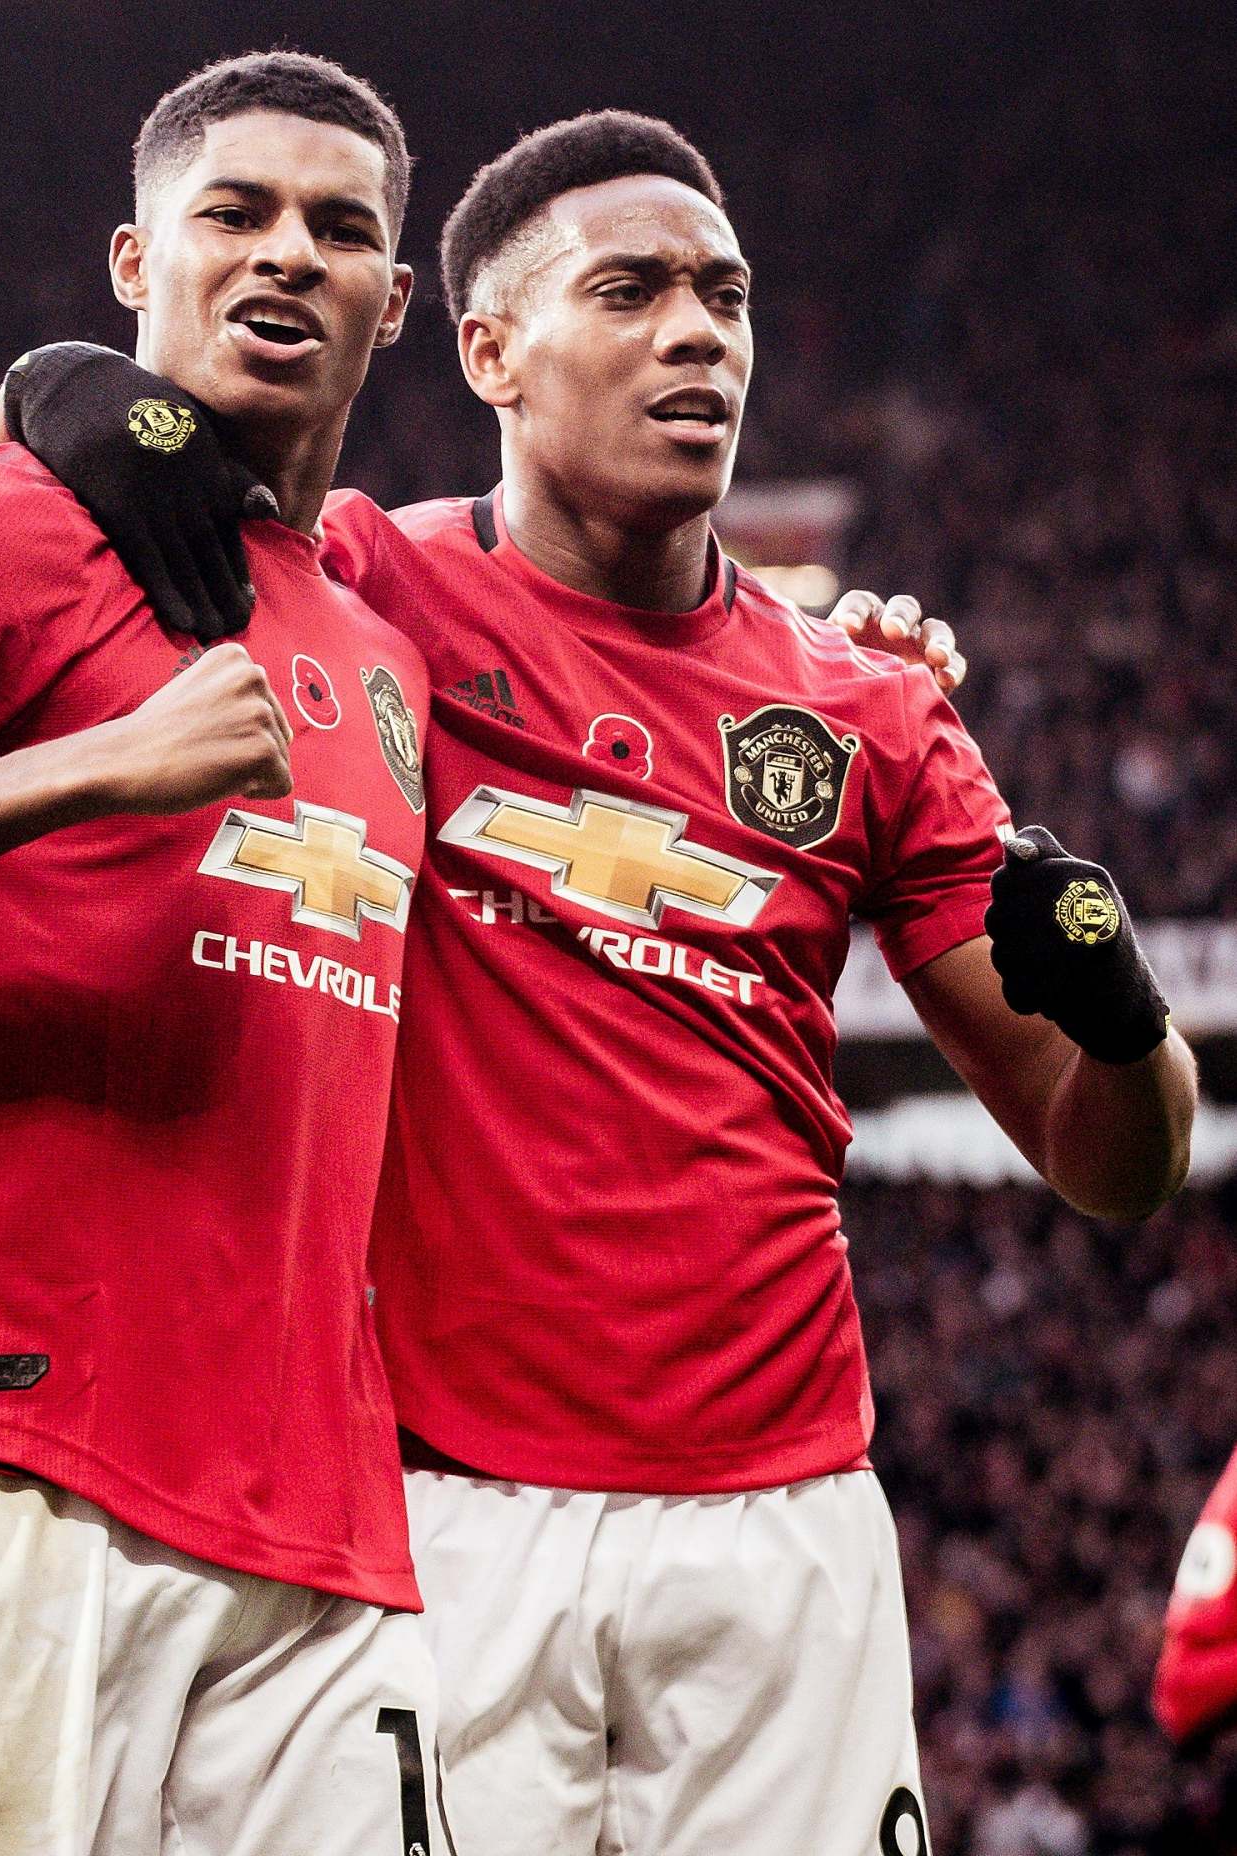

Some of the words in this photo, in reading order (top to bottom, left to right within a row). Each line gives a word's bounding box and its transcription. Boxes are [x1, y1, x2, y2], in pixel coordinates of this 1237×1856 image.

[142, 420, 190, 446] MANCHESTER
[745, 732, 825, 775] MANCHESTER
[755, 802, 809, 824] UNITED
[1060, 885, 1084, 936] MANCHESTER
